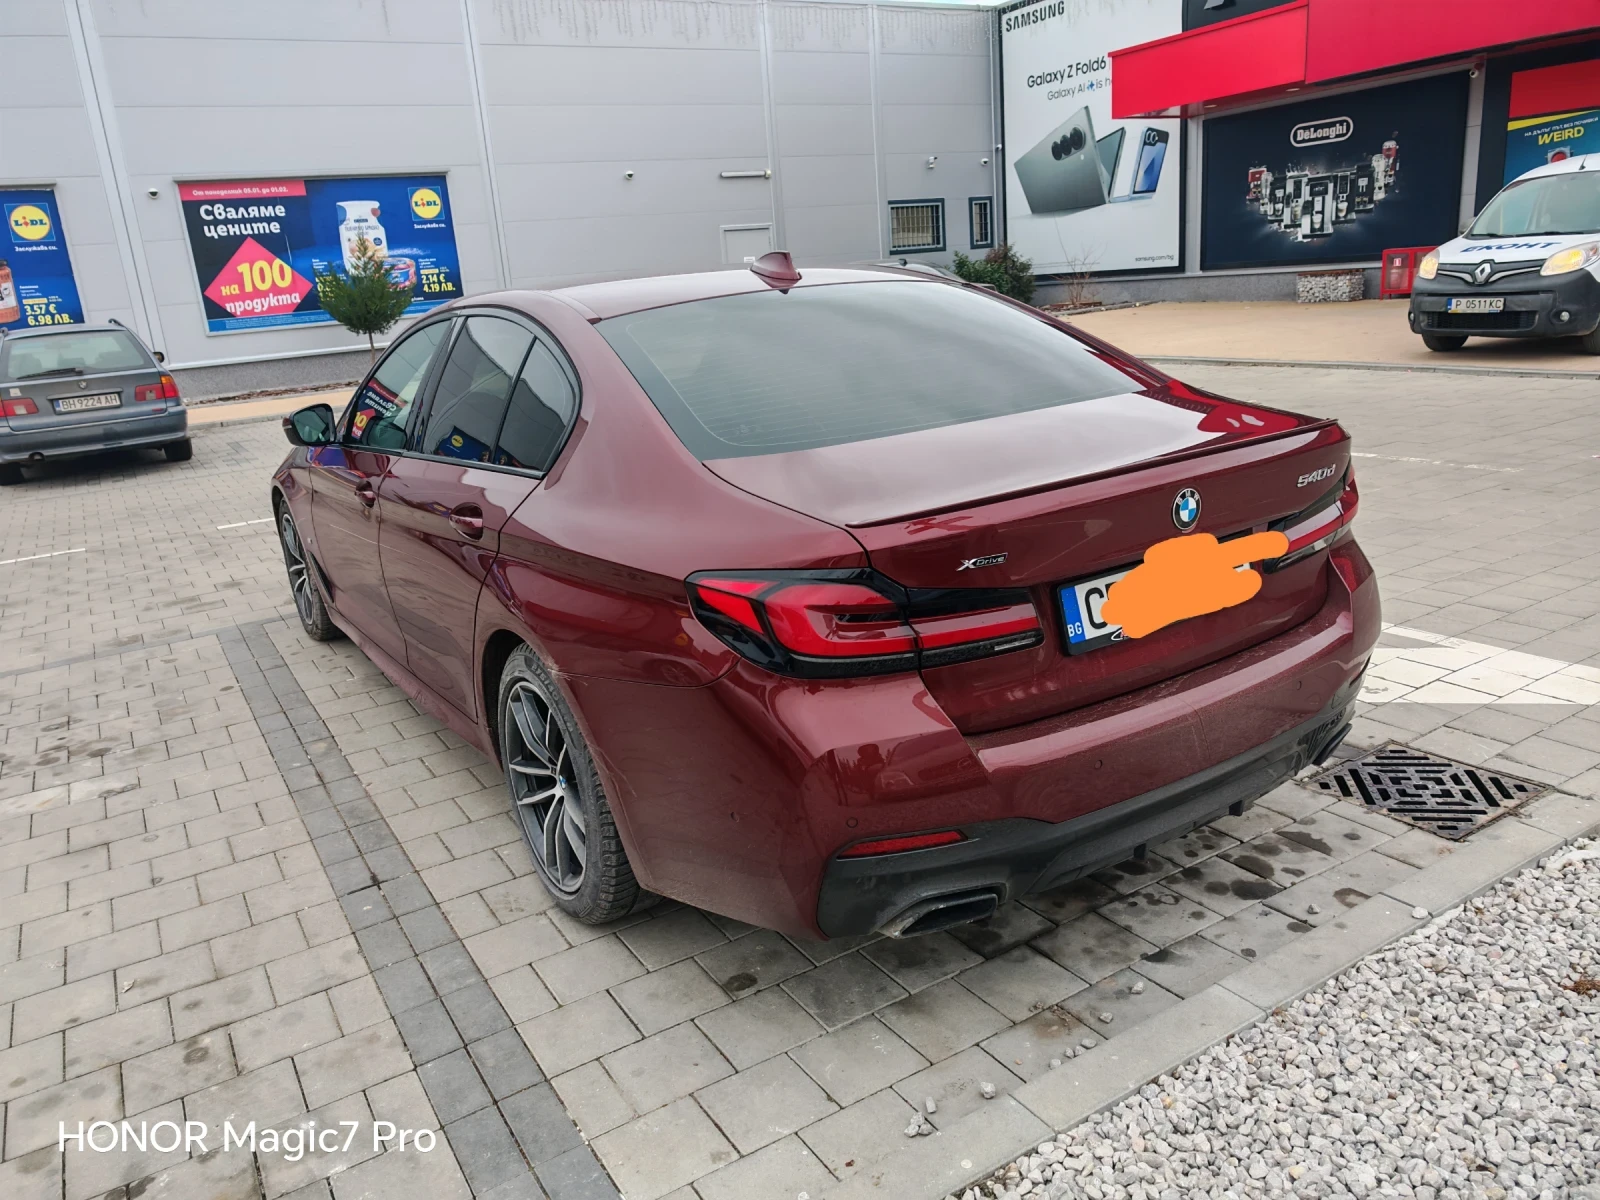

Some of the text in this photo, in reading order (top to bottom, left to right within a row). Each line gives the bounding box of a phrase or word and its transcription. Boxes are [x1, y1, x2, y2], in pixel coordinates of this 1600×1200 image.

[1005, 1, 1065, 32] SAMSUNG
[1027, 56, 1107, 88] Galaxy Z Fold6
[1047, 86, 1077, 101] Galaxy
[1078, 83, 1086, 94] AI
[1096, 79, 1103, 89] is
[1538, 126, 1584, 145] WEIRD
[200, 203, 286, 220] Сваляме
[203, 221, 281, 239] цените
[1135, 254, 1175, 262] samsung.com/bg
[221, 284, 240, 296] на
[237, 258, 292, 293] 100
[421, 273, 446, 284] 2.14 €
[423, 283, 440, 292] 4.19
[24, 304, 57, 315] 3.57 €
[225, 292, 301, 315] продукта
[28, 315, 52, 326] 6.98
[77, 397, 102, 408] 9224
[1297, 464, 1336, 488] 540d
[1067, 622, 1083, 637] BG
